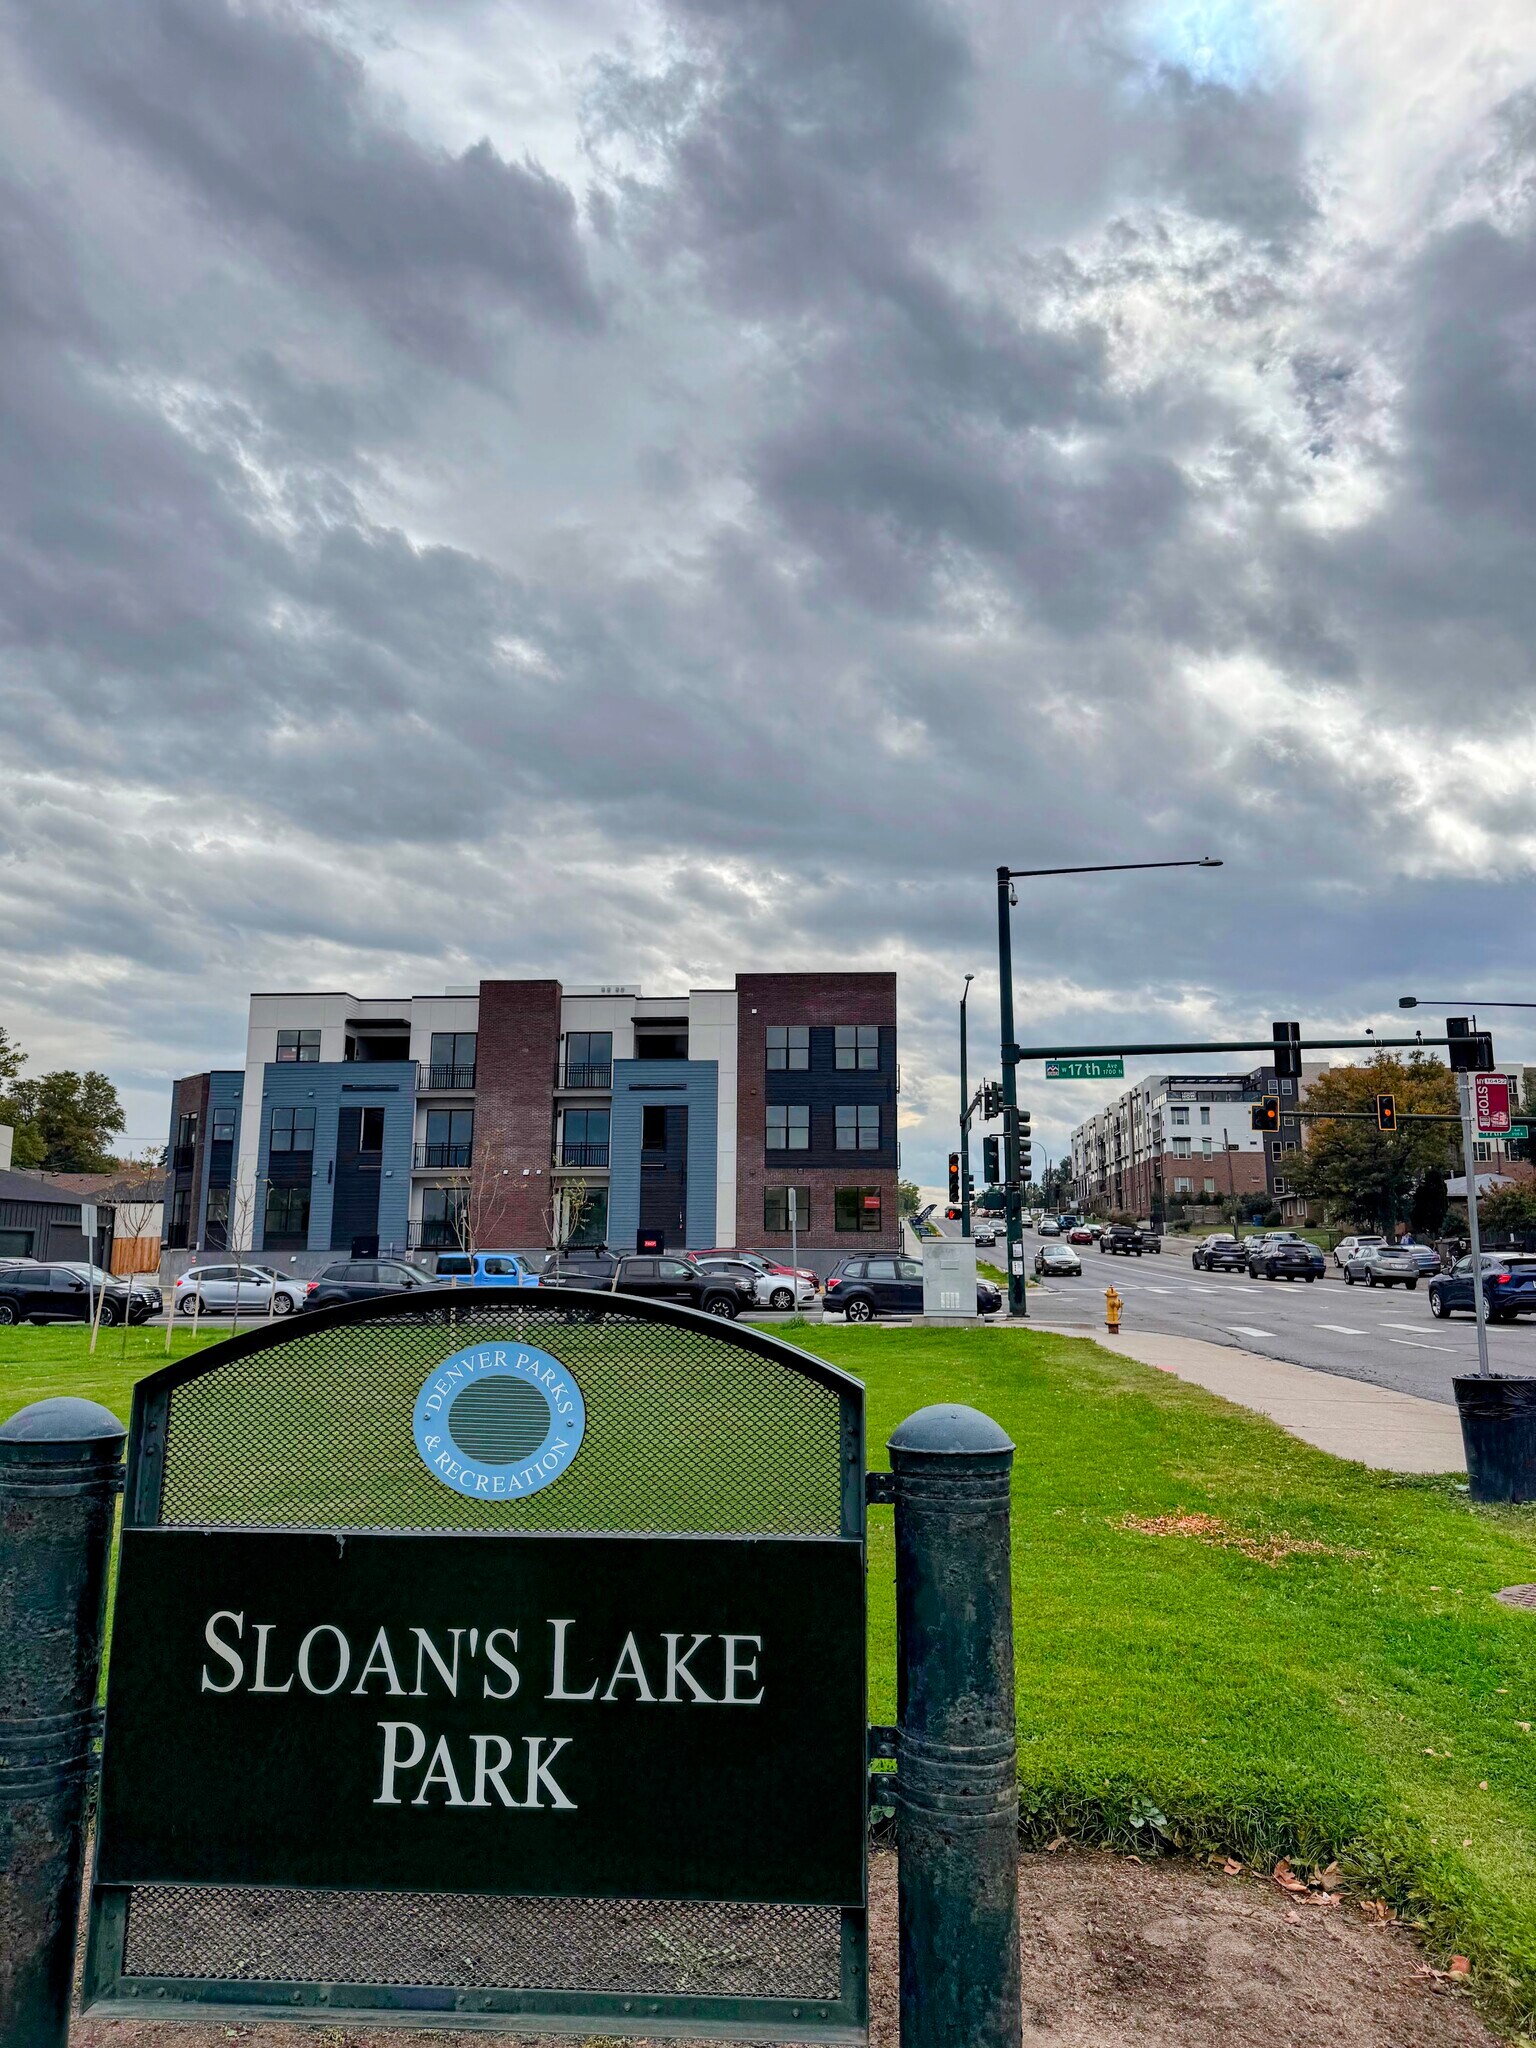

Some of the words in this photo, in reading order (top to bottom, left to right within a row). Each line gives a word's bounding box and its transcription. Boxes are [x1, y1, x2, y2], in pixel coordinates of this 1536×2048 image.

[1068, 1063, 1100, 1076] 17th
[1477, 1086, 1490, 1116] STOP
[425, 1350, 508, 1412] DENVER
[514, 1352, 574, 1414] PARKS
[424, 1435, 441, 1453] &
[433, 1436, 570, 1493] RECREATION
[200, 1610, 521, 1700] SLOAN'S
[543, 1618, 766, 1705] LAKE
[372, 1721, 579, 1810] PARK
